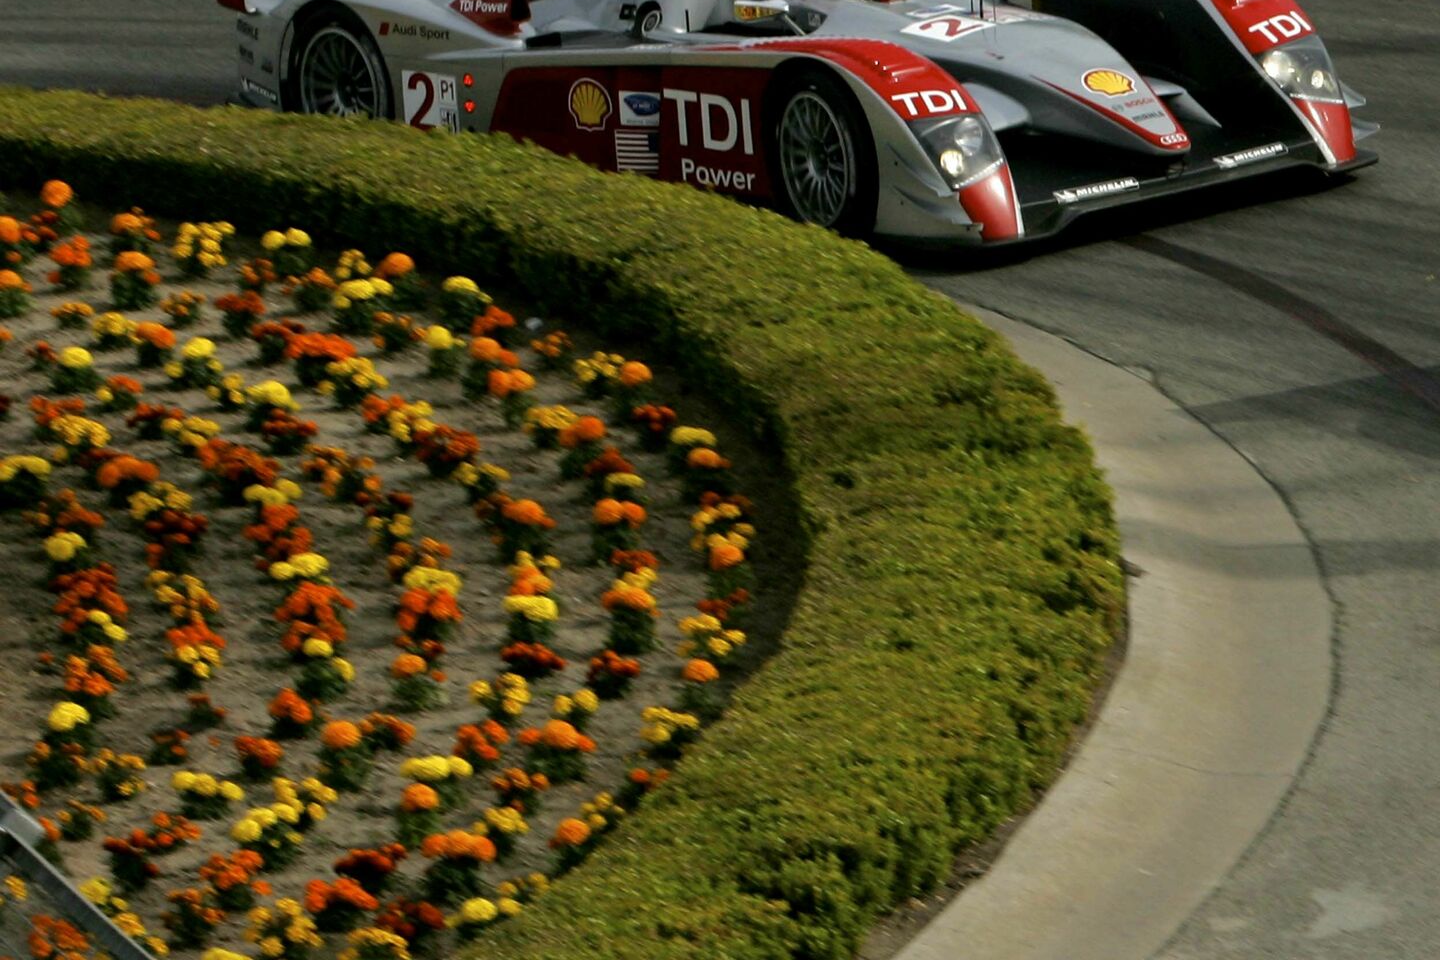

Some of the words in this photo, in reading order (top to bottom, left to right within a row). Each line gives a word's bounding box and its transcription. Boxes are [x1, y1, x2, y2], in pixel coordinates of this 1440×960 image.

[475, 1, 508, 14] Power
[392, 23, 417, 37] Audi
[420, 27, 450, 41] Sport
[918, 17, 985, 38] 2
[1248, 10, 1312, 44] TDI
[407, 72, 437, 131] 2
[439, 80, 455, 101] P1
[891, 89, 968, 116] TDI
[662, 87, 754, 156] TDI
[1234, 143, 1284, 162] MICHELIN
[681, 157, 756, 191] Power
[1076, 178, 1137, 197] MICHELIN
